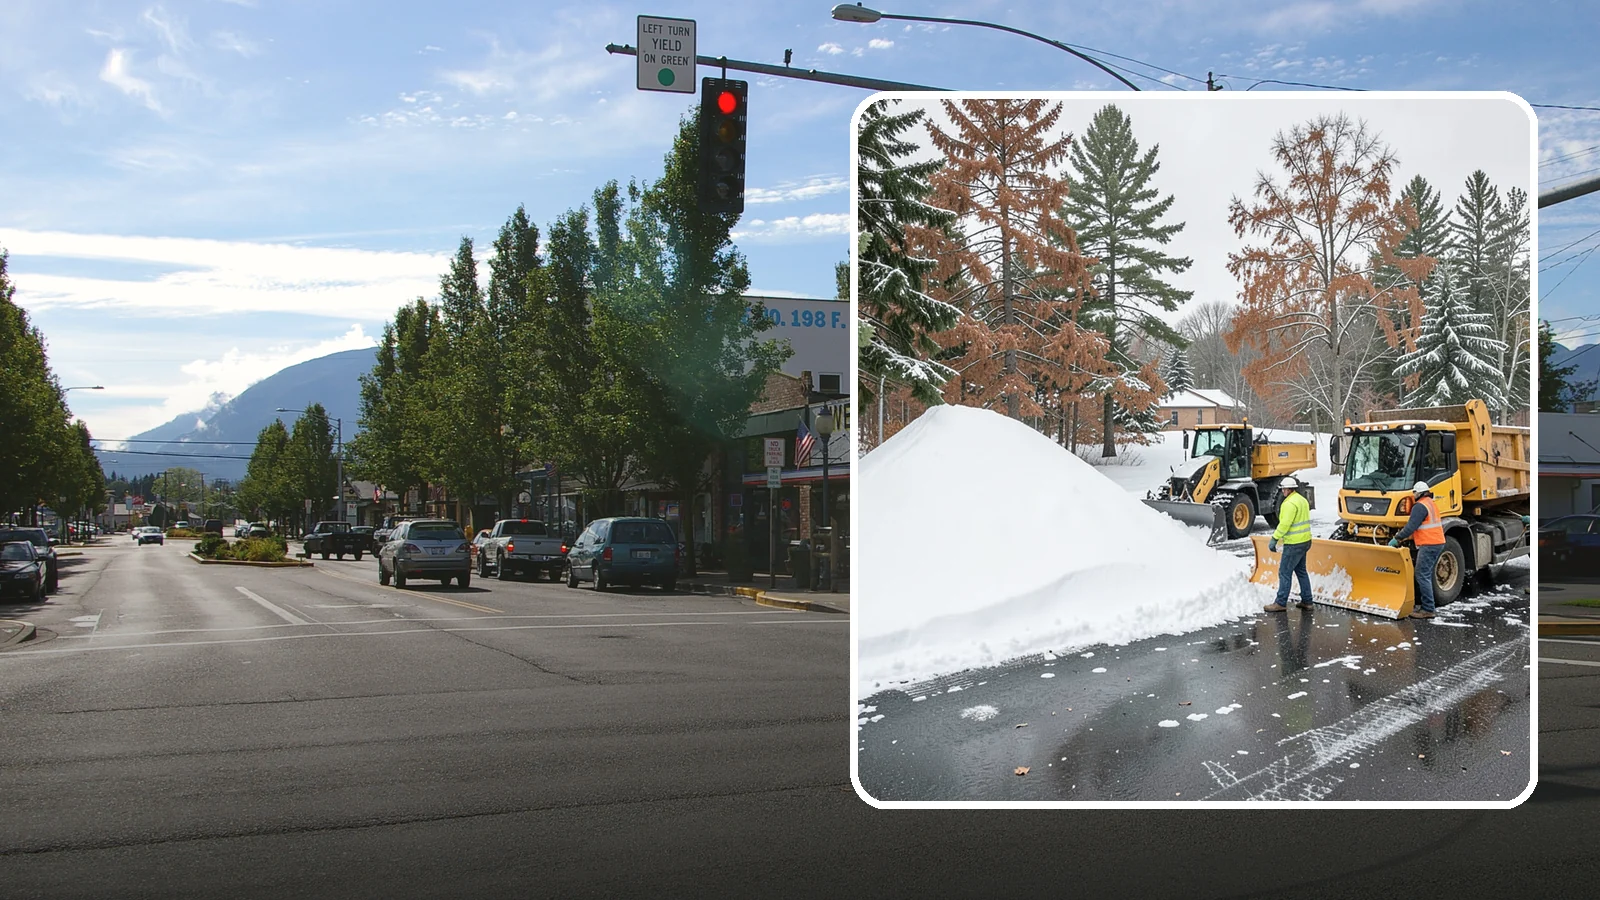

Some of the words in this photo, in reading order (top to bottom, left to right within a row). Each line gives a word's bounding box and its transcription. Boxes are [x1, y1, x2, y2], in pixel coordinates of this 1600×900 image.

[643, 23, 663, 34] LEFT
[668, 26, 690, 36] TURN
[652, 38, 682, 51] YIELD
[644, 53, 656, 64] ON
[661, 55, 689, 66] GREEN
[791, 309, 826, 328] 198
[831, 311, 846, 329] F.
